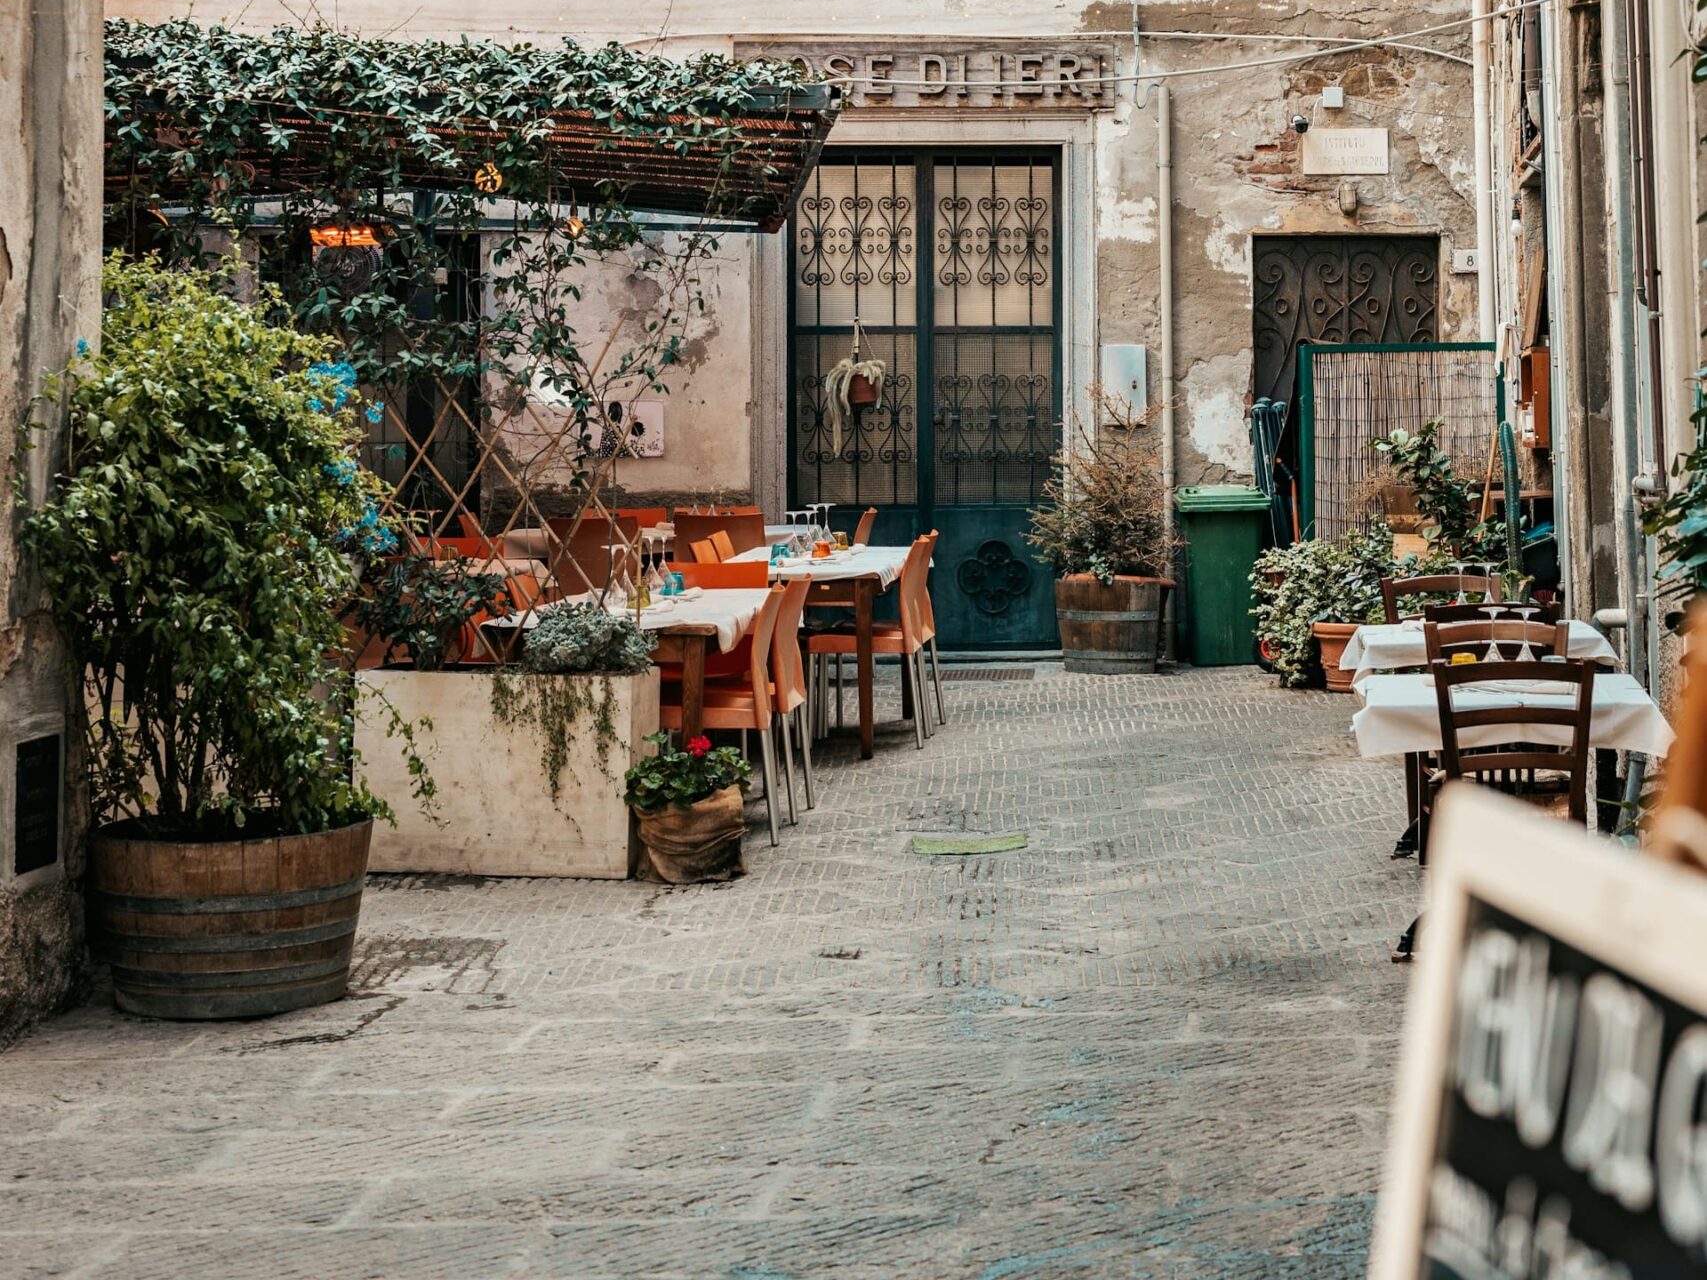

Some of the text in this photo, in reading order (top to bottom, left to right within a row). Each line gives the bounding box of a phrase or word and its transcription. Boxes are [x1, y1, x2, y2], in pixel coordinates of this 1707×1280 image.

[917, 53, 968, 97] DI
[991, 53, 1104, 97] IERI
[1465, 255, 1474, 267] 8
